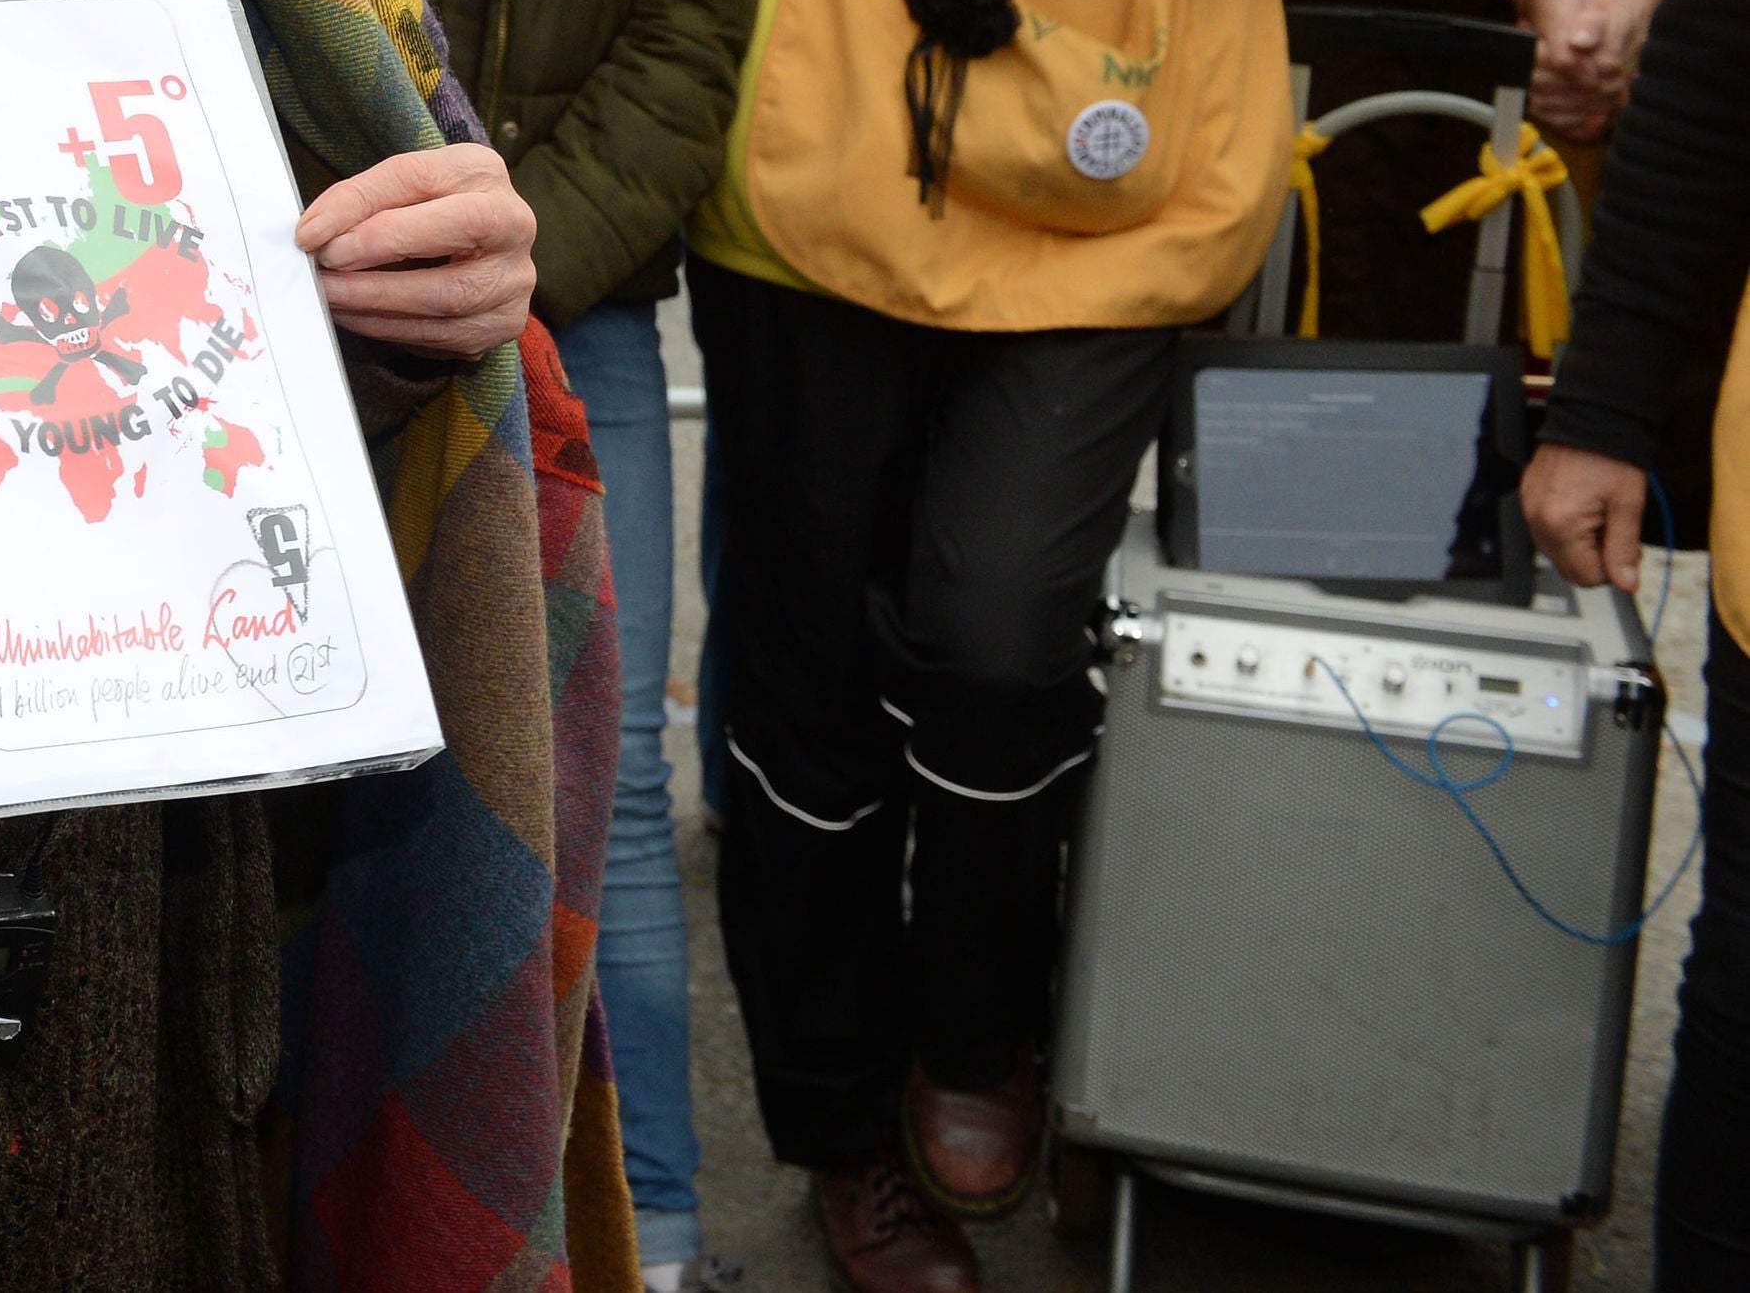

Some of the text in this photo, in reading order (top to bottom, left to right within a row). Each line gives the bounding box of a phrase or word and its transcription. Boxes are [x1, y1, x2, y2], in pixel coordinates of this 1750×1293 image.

[46, 195, 97, 231] TO
[113, 204, 204, 263] LIVE
[11, 404, 152, 457] YOUNG
[153, 376, 199, 420] TO
[193, 317, 245, 385] DIE
[202, 588, 298, 651] Land
[14, 680, 80, 719] billion
[90, 663, 152, 724] people
[161, 654, 231, 701] alive
